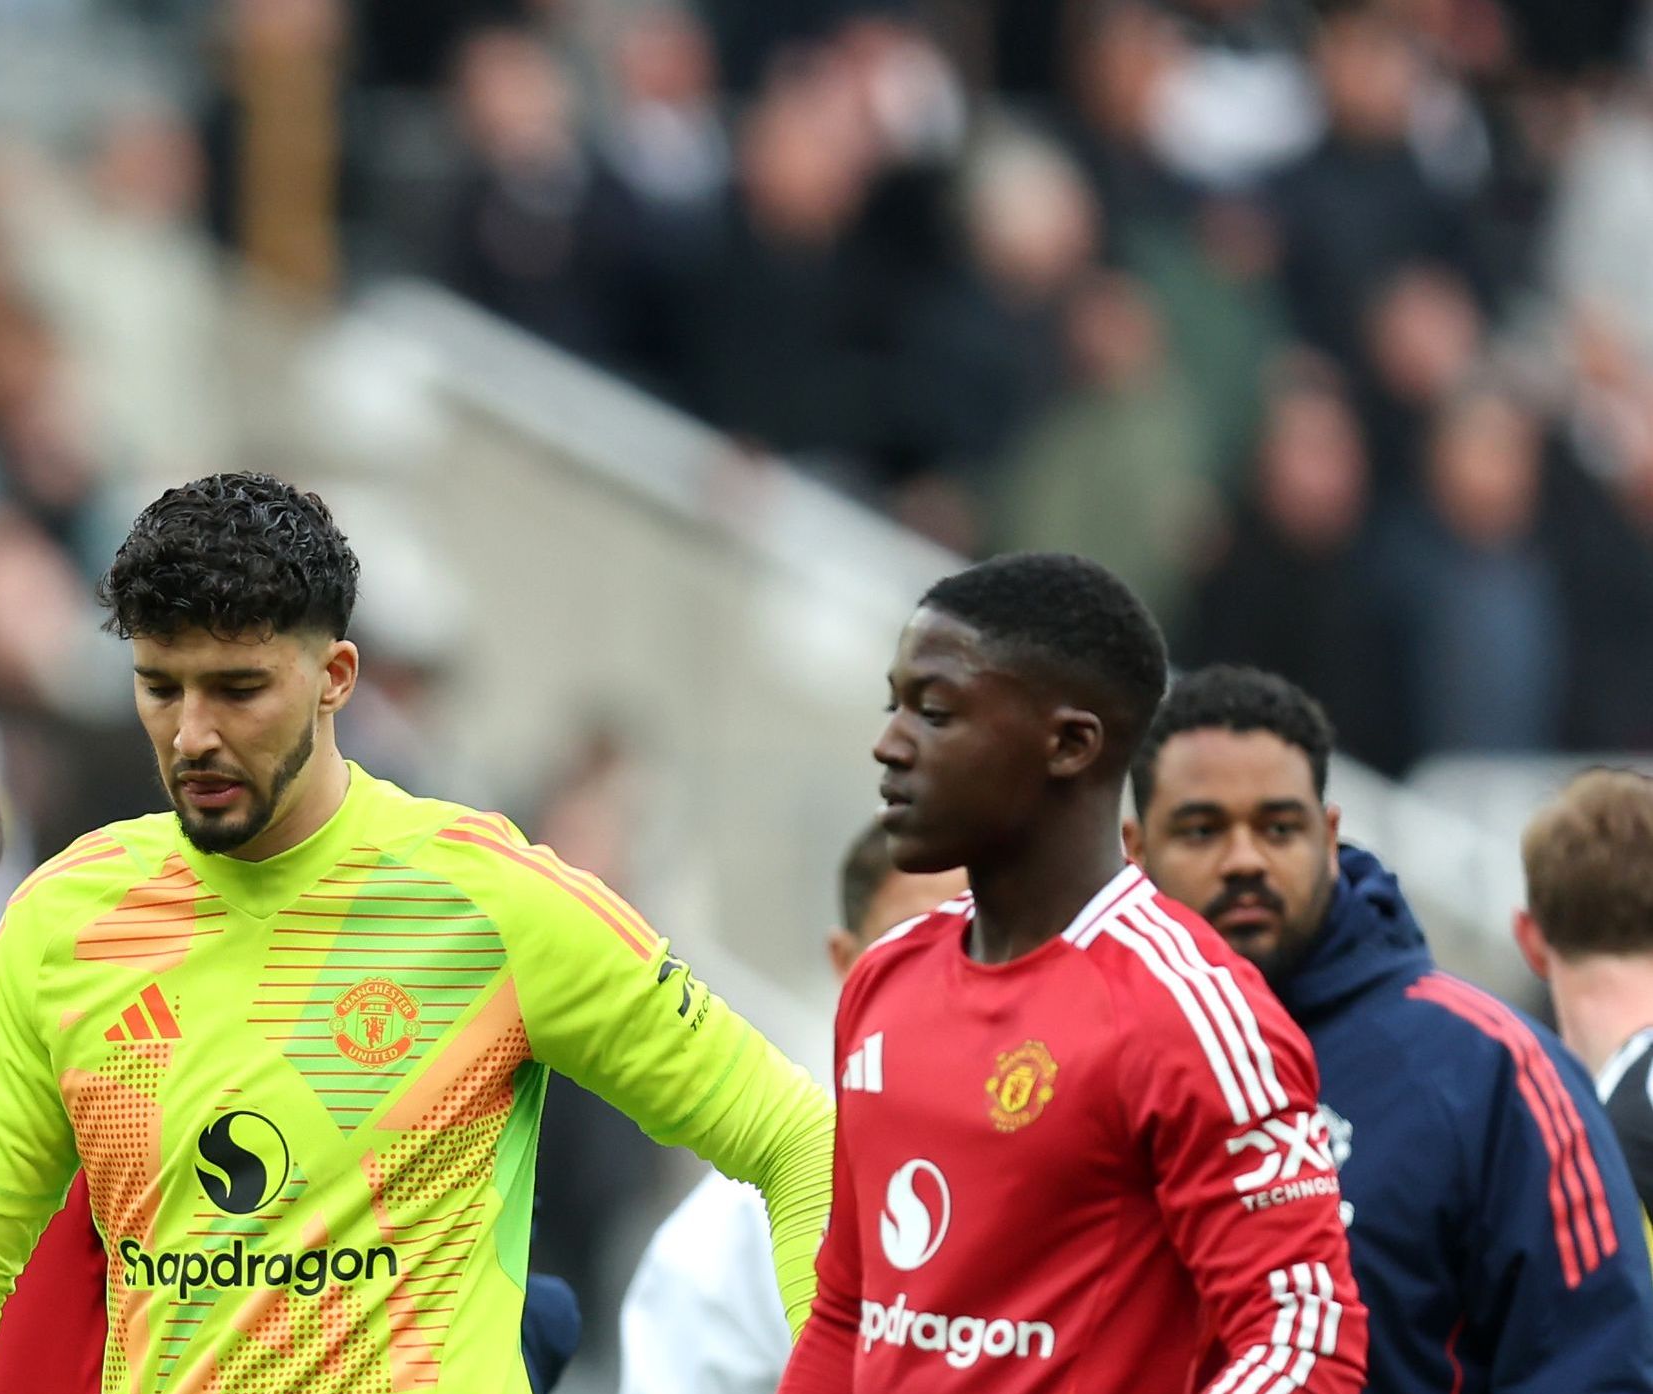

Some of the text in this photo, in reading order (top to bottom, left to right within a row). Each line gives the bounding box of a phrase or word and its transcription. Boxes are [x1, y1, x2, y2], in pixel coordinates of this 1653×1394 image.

[340, 983, 412, 1017] MANCHESTER
[348, 1048, 399, 1063] UNITED
[1241, 1175, 1341, 1213] TECHNOL
[119, 1238, 398, 1300] Snapdragon
[860, 1292, 1055, 1369] pdragon
